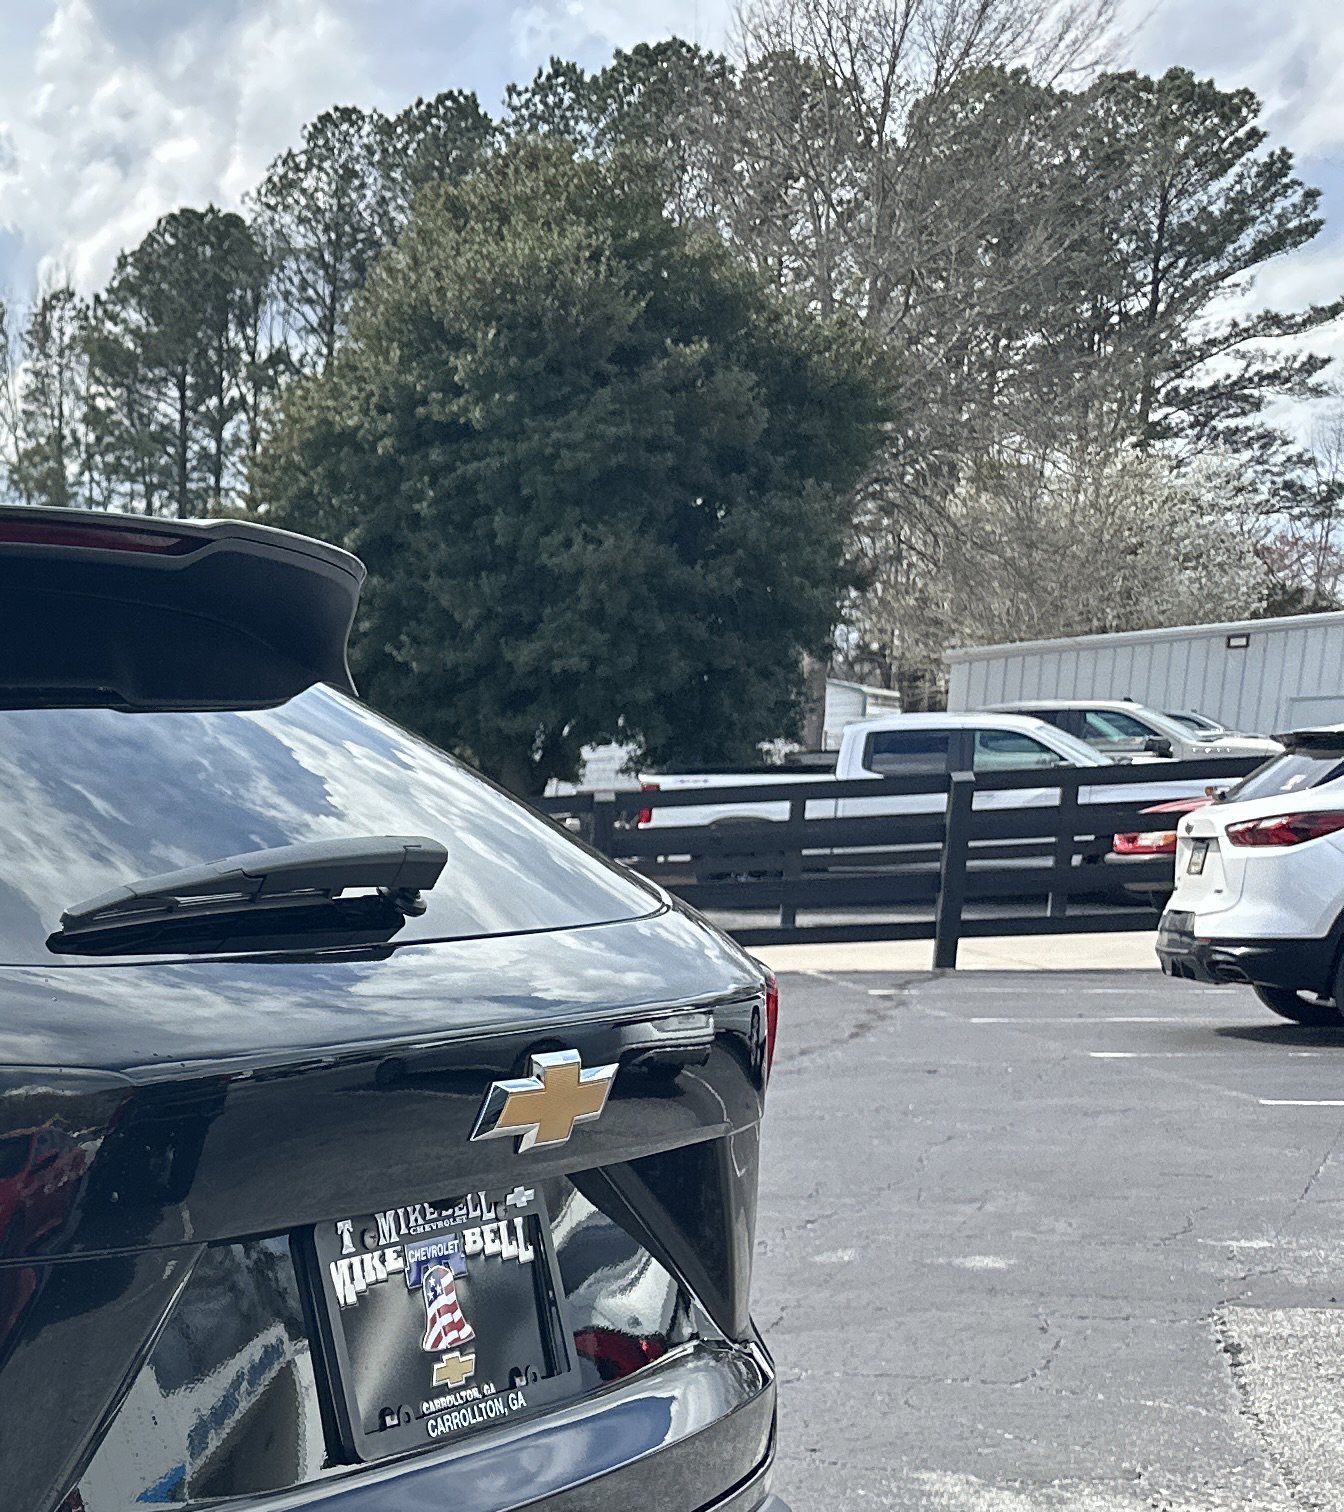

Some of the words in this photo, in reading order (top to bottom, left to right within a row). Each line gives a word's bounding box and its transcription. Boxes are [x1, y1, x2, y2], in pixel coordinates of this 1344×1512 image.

[410, 1215, 468, 1235] CHEVROLET
[408, 1240, 461, 1263] CHEVROLET
[462, 1216, 534, 1265] BELL
[483, 1382, 497, 1396] GA
[427, 1397, 509, 1438] CARROLLTON,
[508, 1390, 527, 1411] GA
